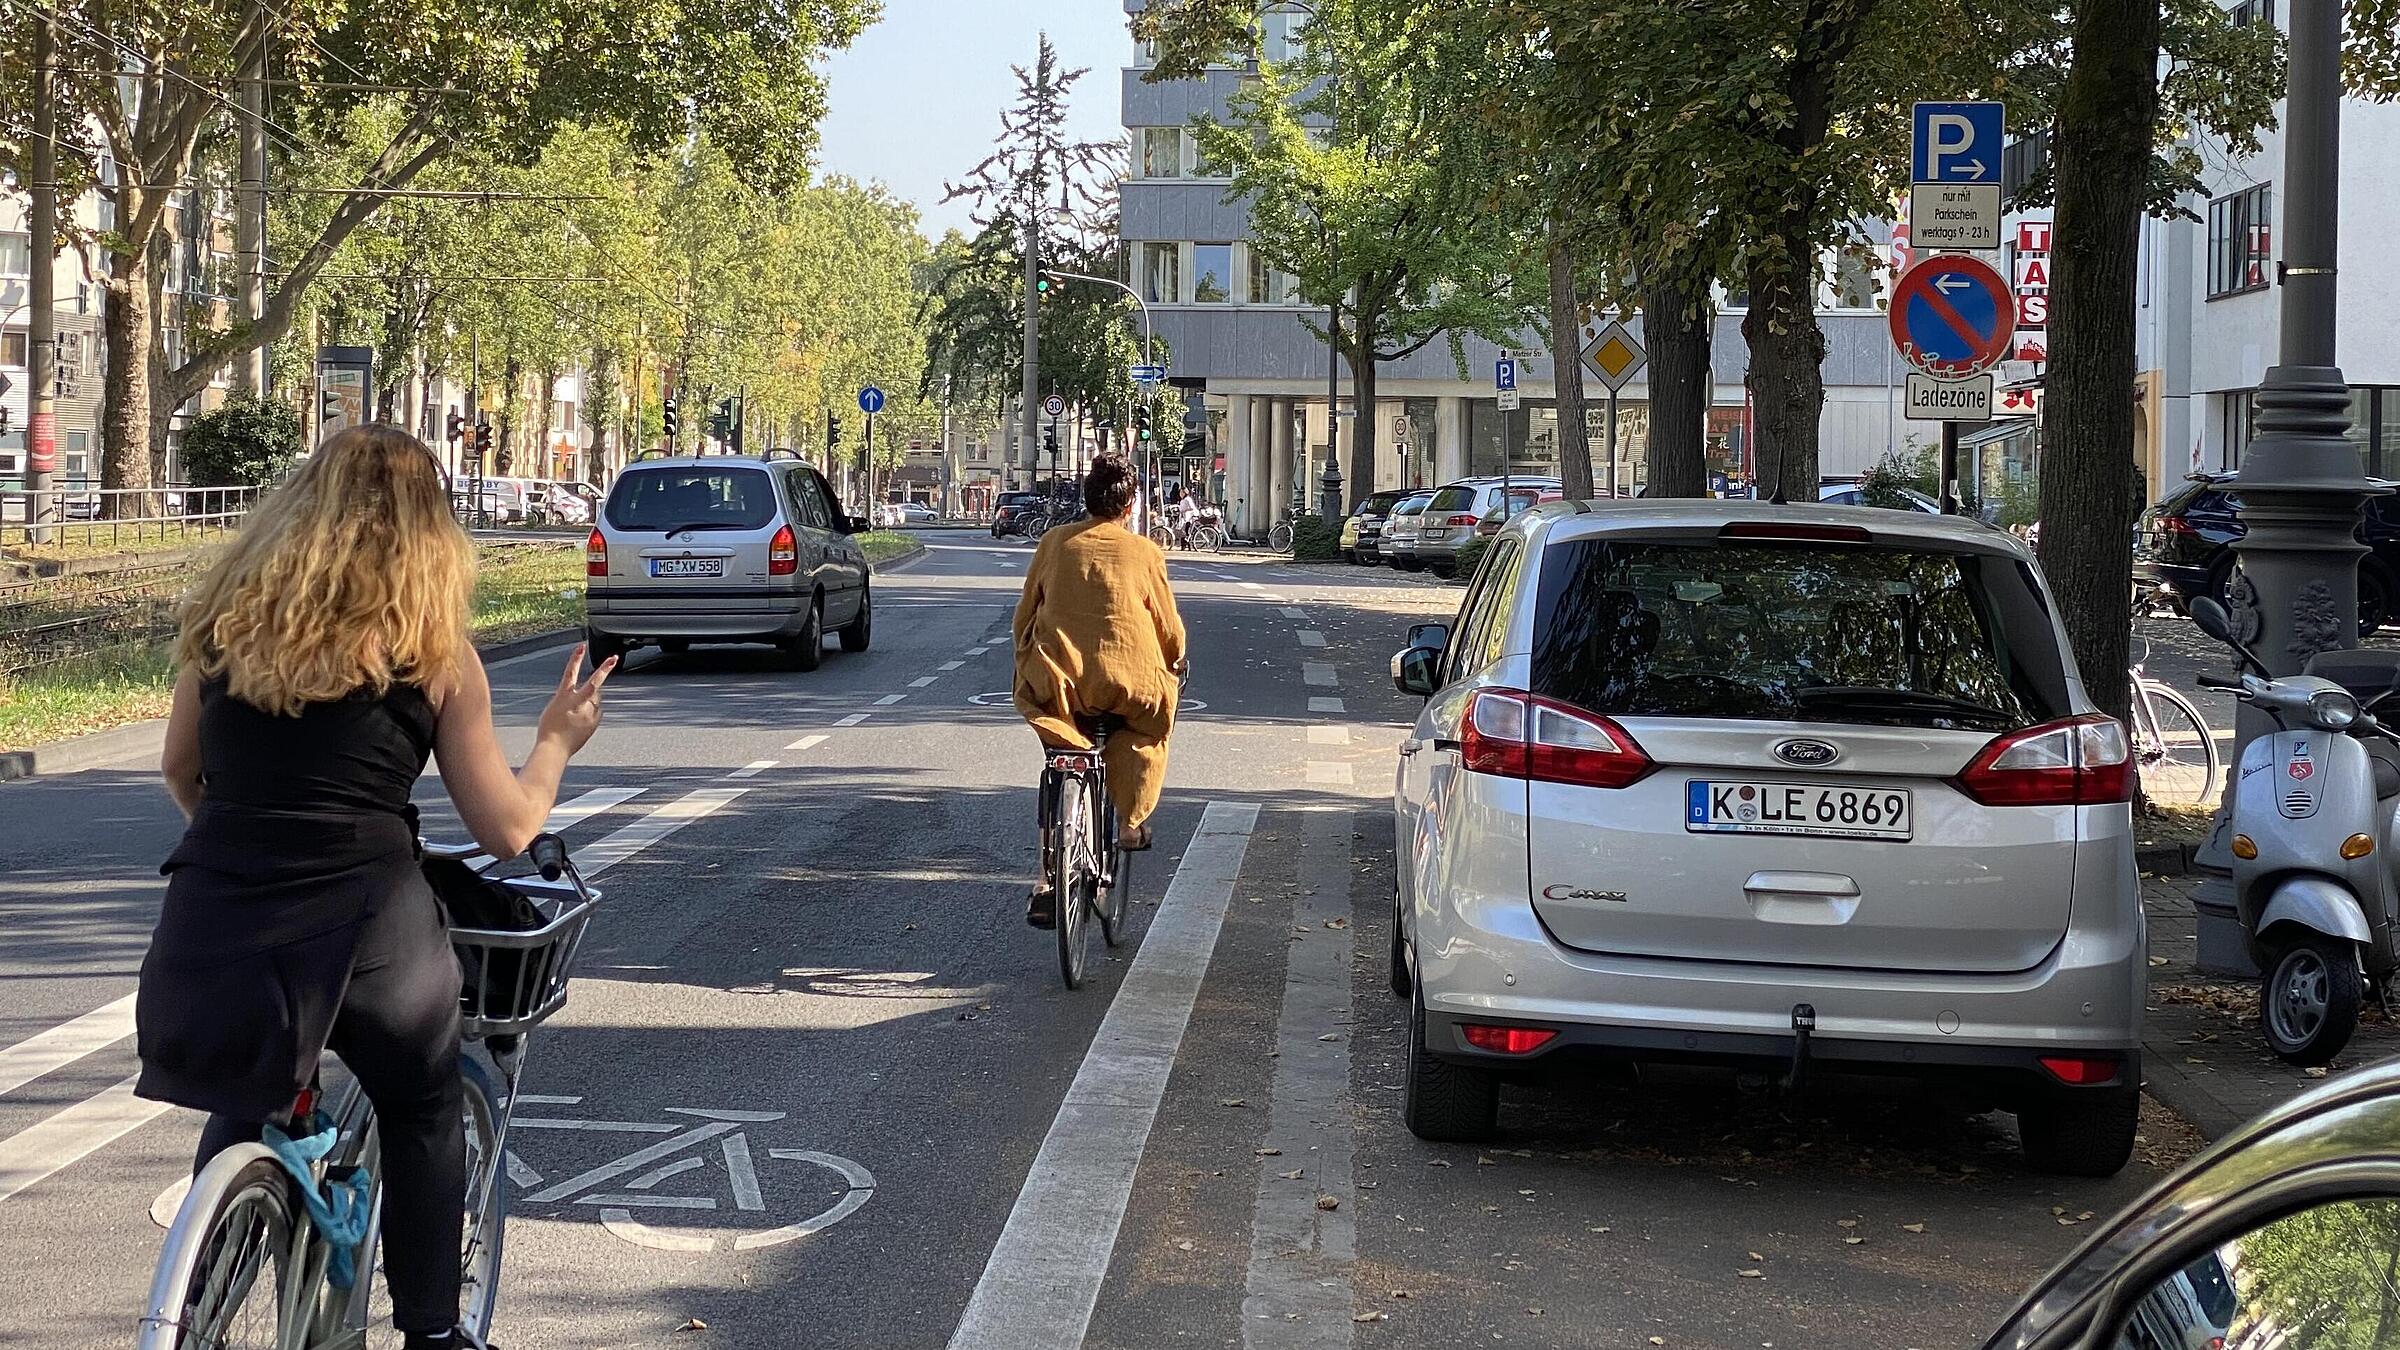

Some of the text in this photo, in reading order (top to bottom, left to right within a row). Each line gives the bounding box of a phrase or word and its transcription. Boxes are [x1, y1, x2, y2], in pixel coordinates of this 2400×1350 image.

[1926, 113, 1976, 180] P
[1942, 190, 1971, 202] nur mit
[1934, 208, 1978, 221] Parkschein
[1921, 226, 1957, 241] werktags
[1958, 226, 1965, 238] 9
[1971, 226, 1982, 238] 23
[1983, 226, 1990, 238] h
[2024, 223, 2049, 323] TAS
[1499, 364, 1511, 386] P
[1048, 400, 1061, 411] 30
[658, 560, 720, 573] MG XW 558
[1789, 743, 1825, 760] Ford
[1694, 807, 1704, 817] D
[1712, 786, 1904, 828] K LE 6869
